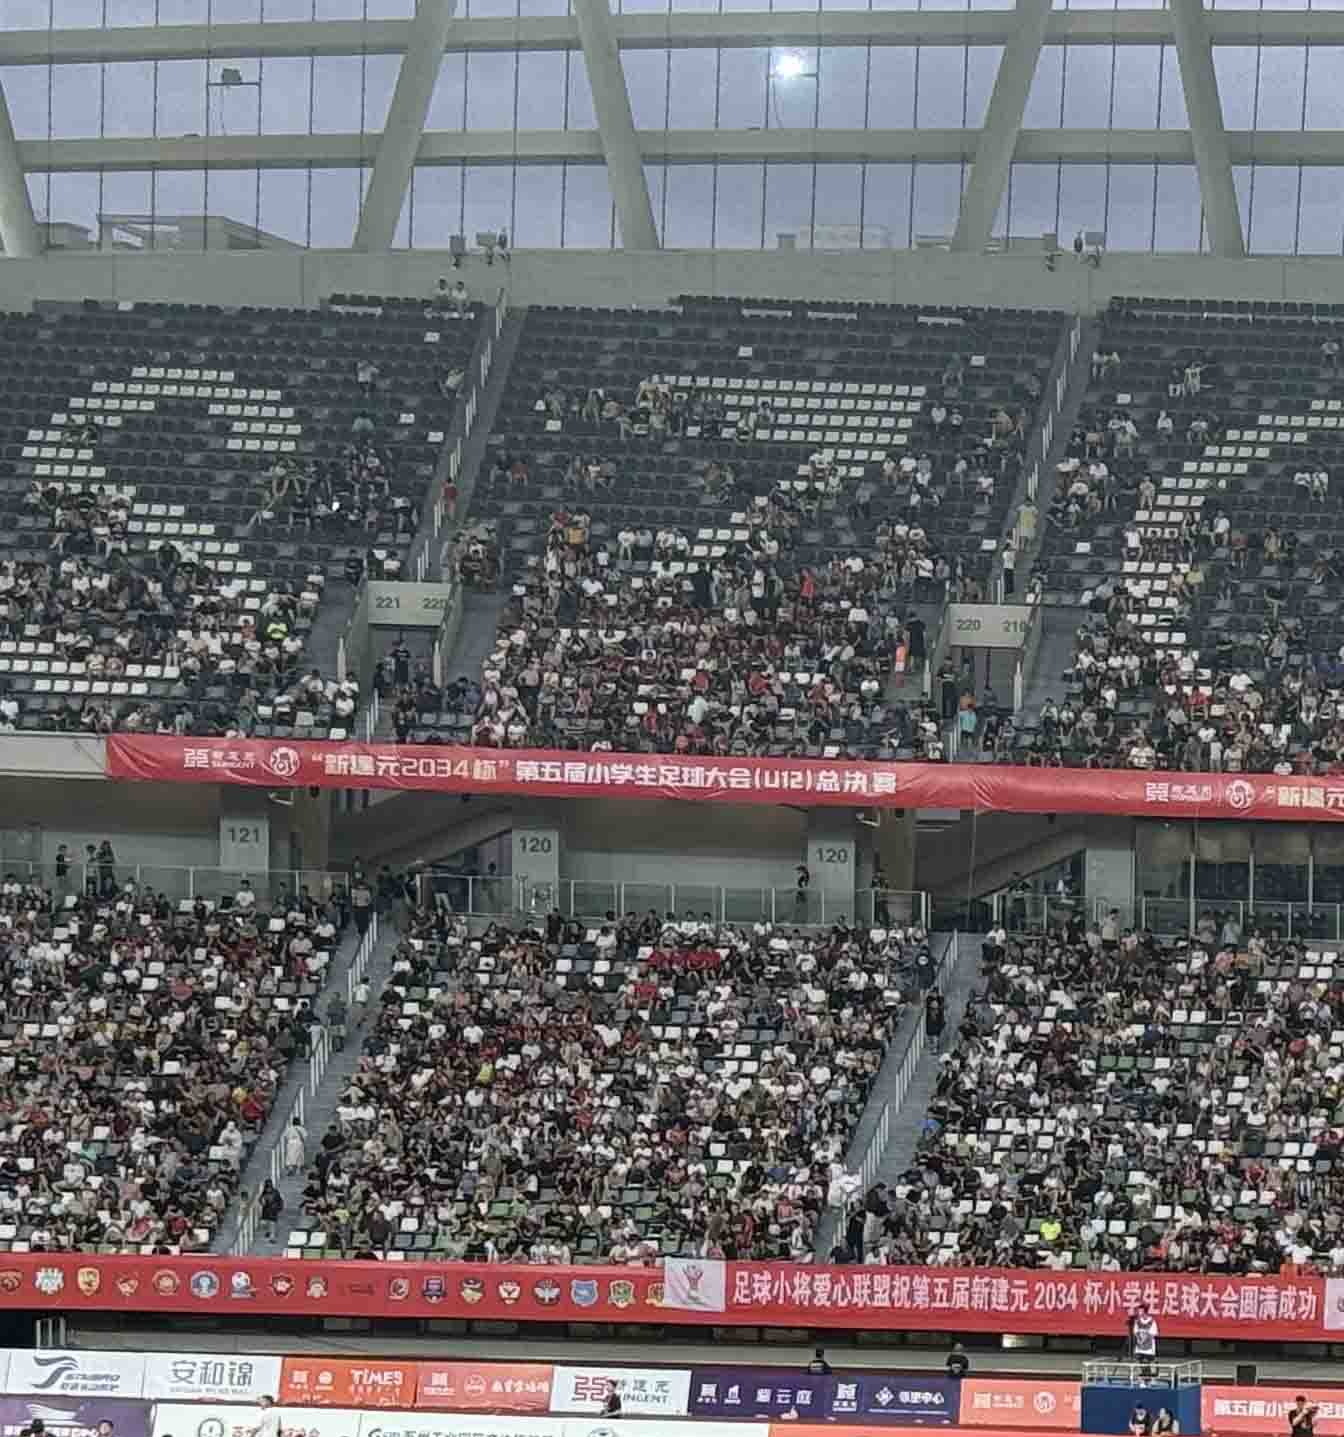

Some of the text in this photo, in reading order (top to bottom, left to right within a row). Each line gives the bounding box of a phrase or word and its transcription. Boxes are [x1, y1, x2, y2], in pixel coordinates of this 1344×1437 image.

[375, 597, 400, 609] 221
[228, 826, 261, 843] 121
[519, 837, 552, 854] 120
[815, 848, 849, 864] 120
[732, 1271, 1319, 1322] 足球小将爱心联盟祝第五届新建元 2034 杯小学生足球大会圆满成功
[169, 1360, 254, 1387] 安和锦
[351, 1368, 403, 1386] TIMES
